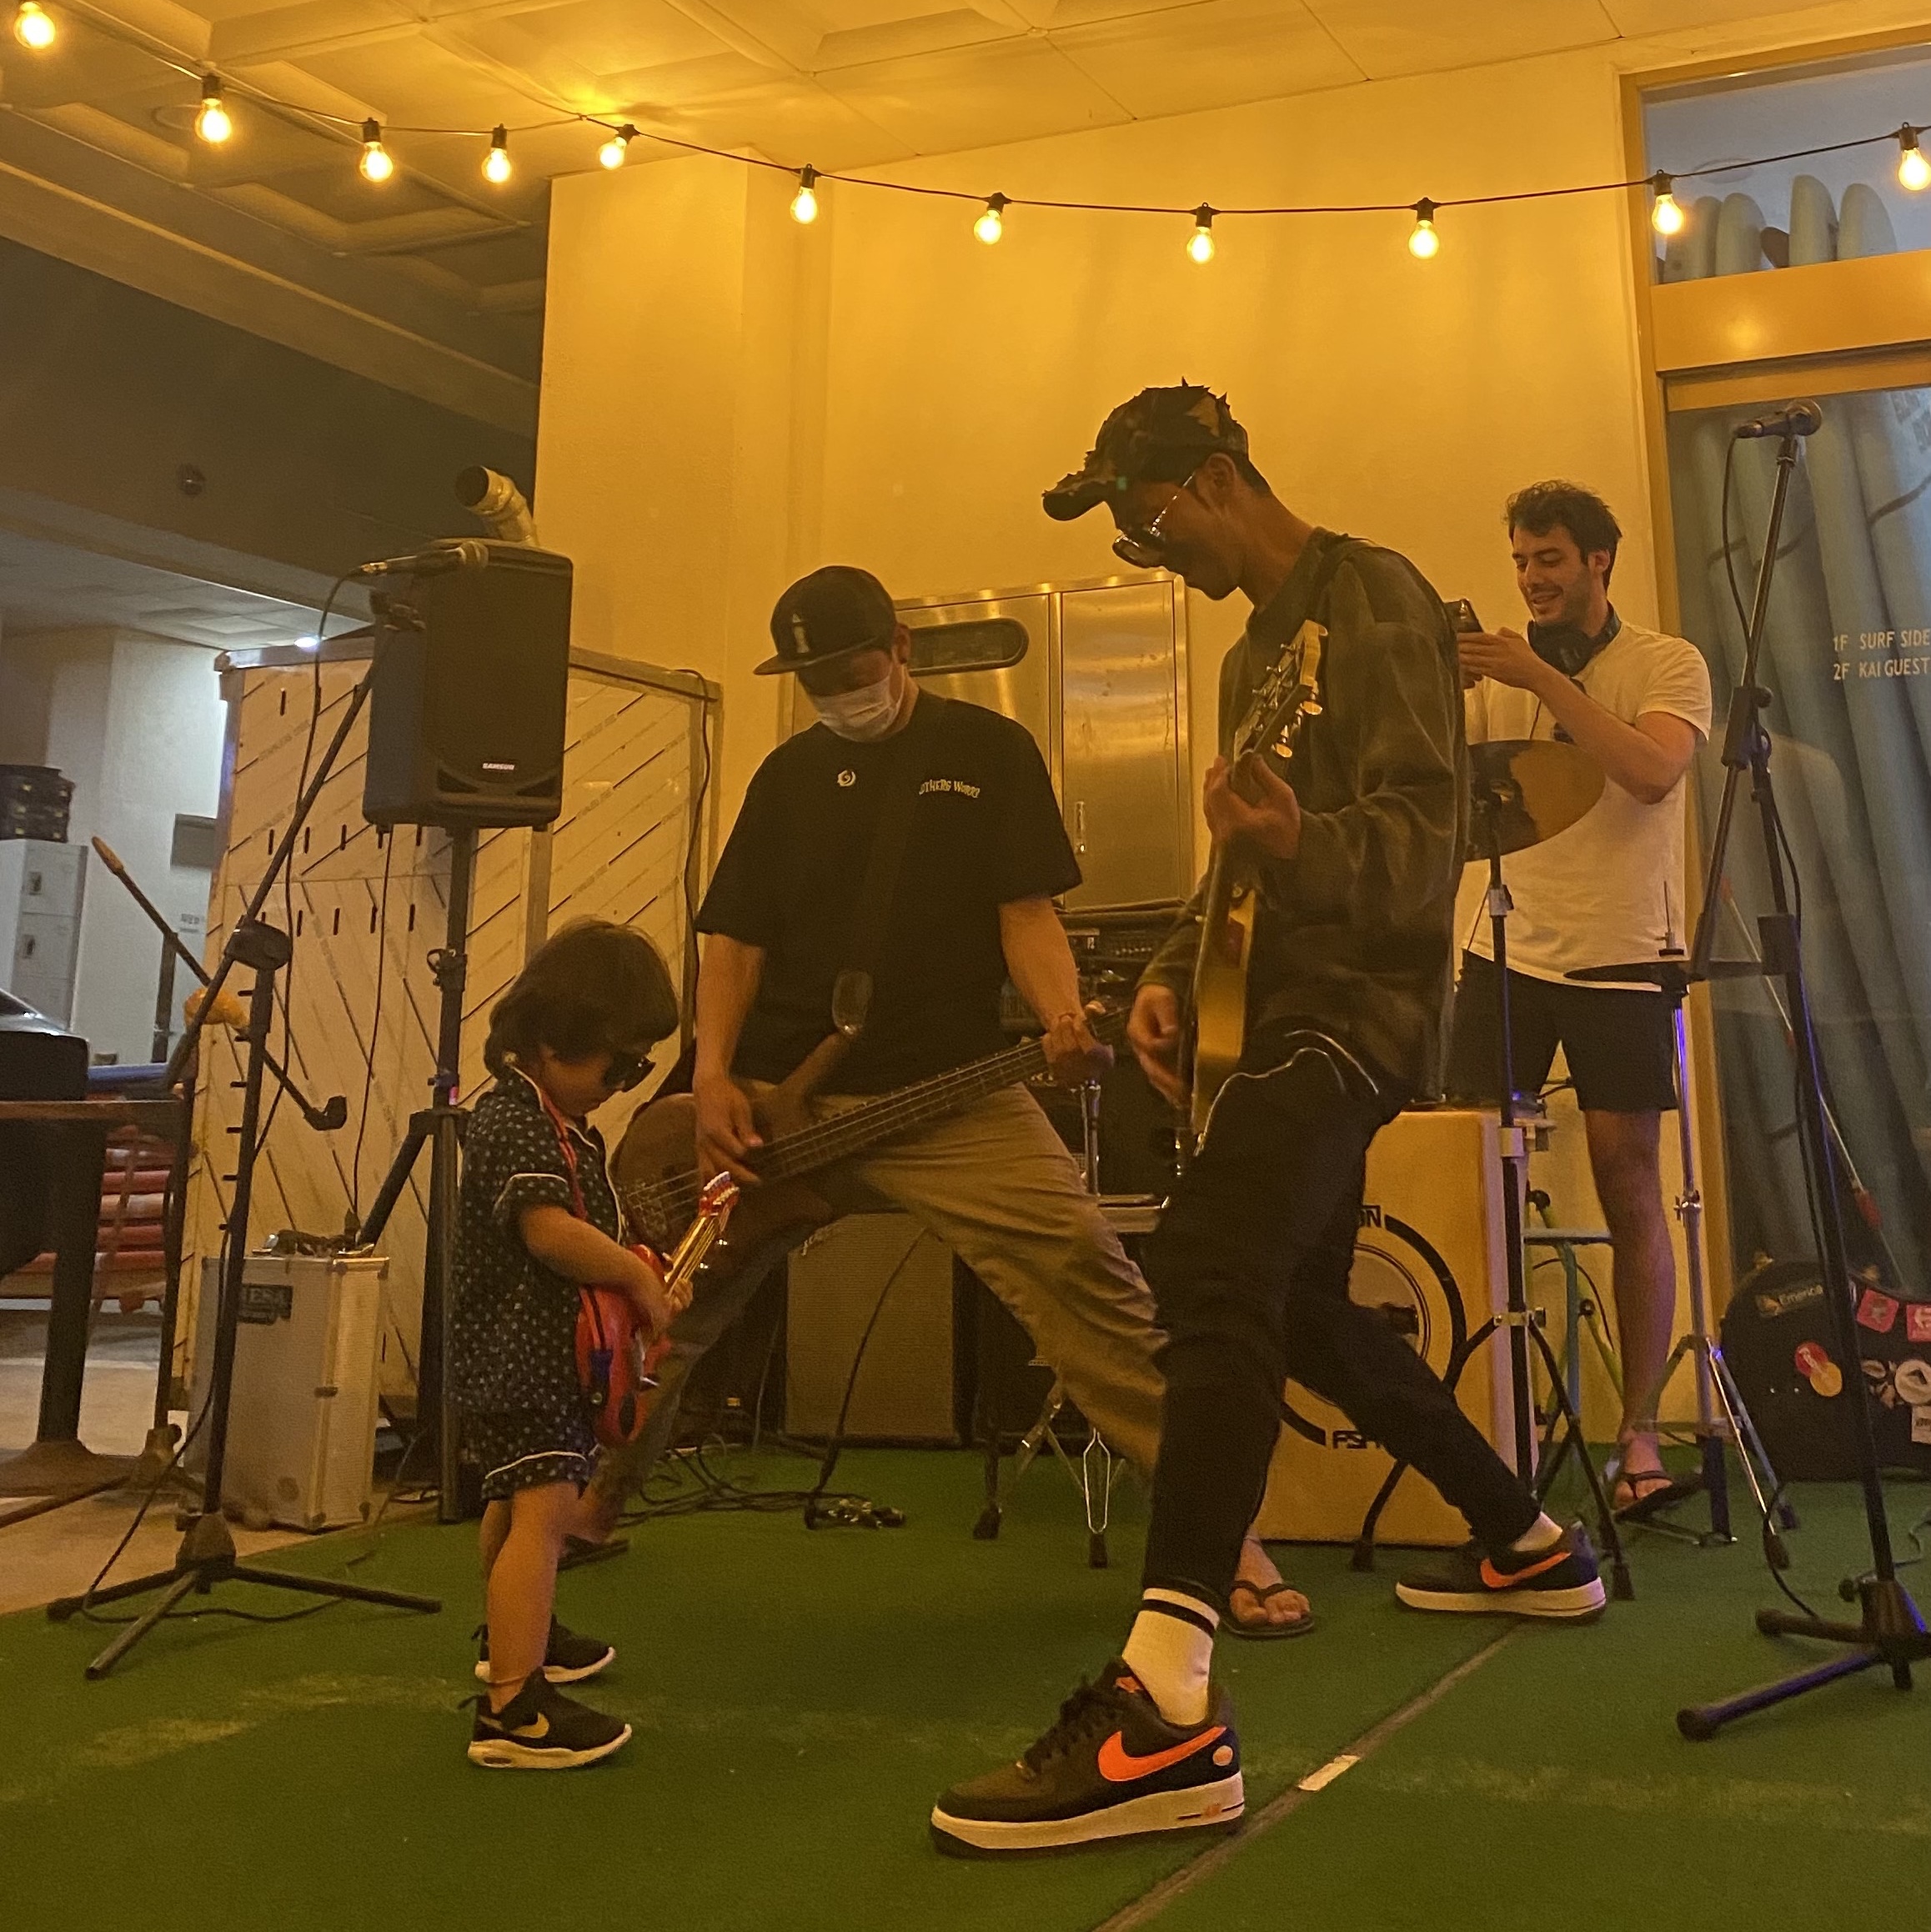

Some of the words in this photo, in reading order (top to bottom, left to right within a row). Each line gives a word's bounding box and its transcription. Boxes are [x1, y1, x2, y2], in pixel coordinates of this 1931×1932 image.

[1833, 635, 1848, 651] 1F
[1859, 631, 1895, 650] SURF
[1900, 629, 1931, 648] SIDE
[1833, 663, 1850, 680] 2F
[1859, 660, 1881, 678] KAI
[1884, 656, 1931, 677] GUEST
